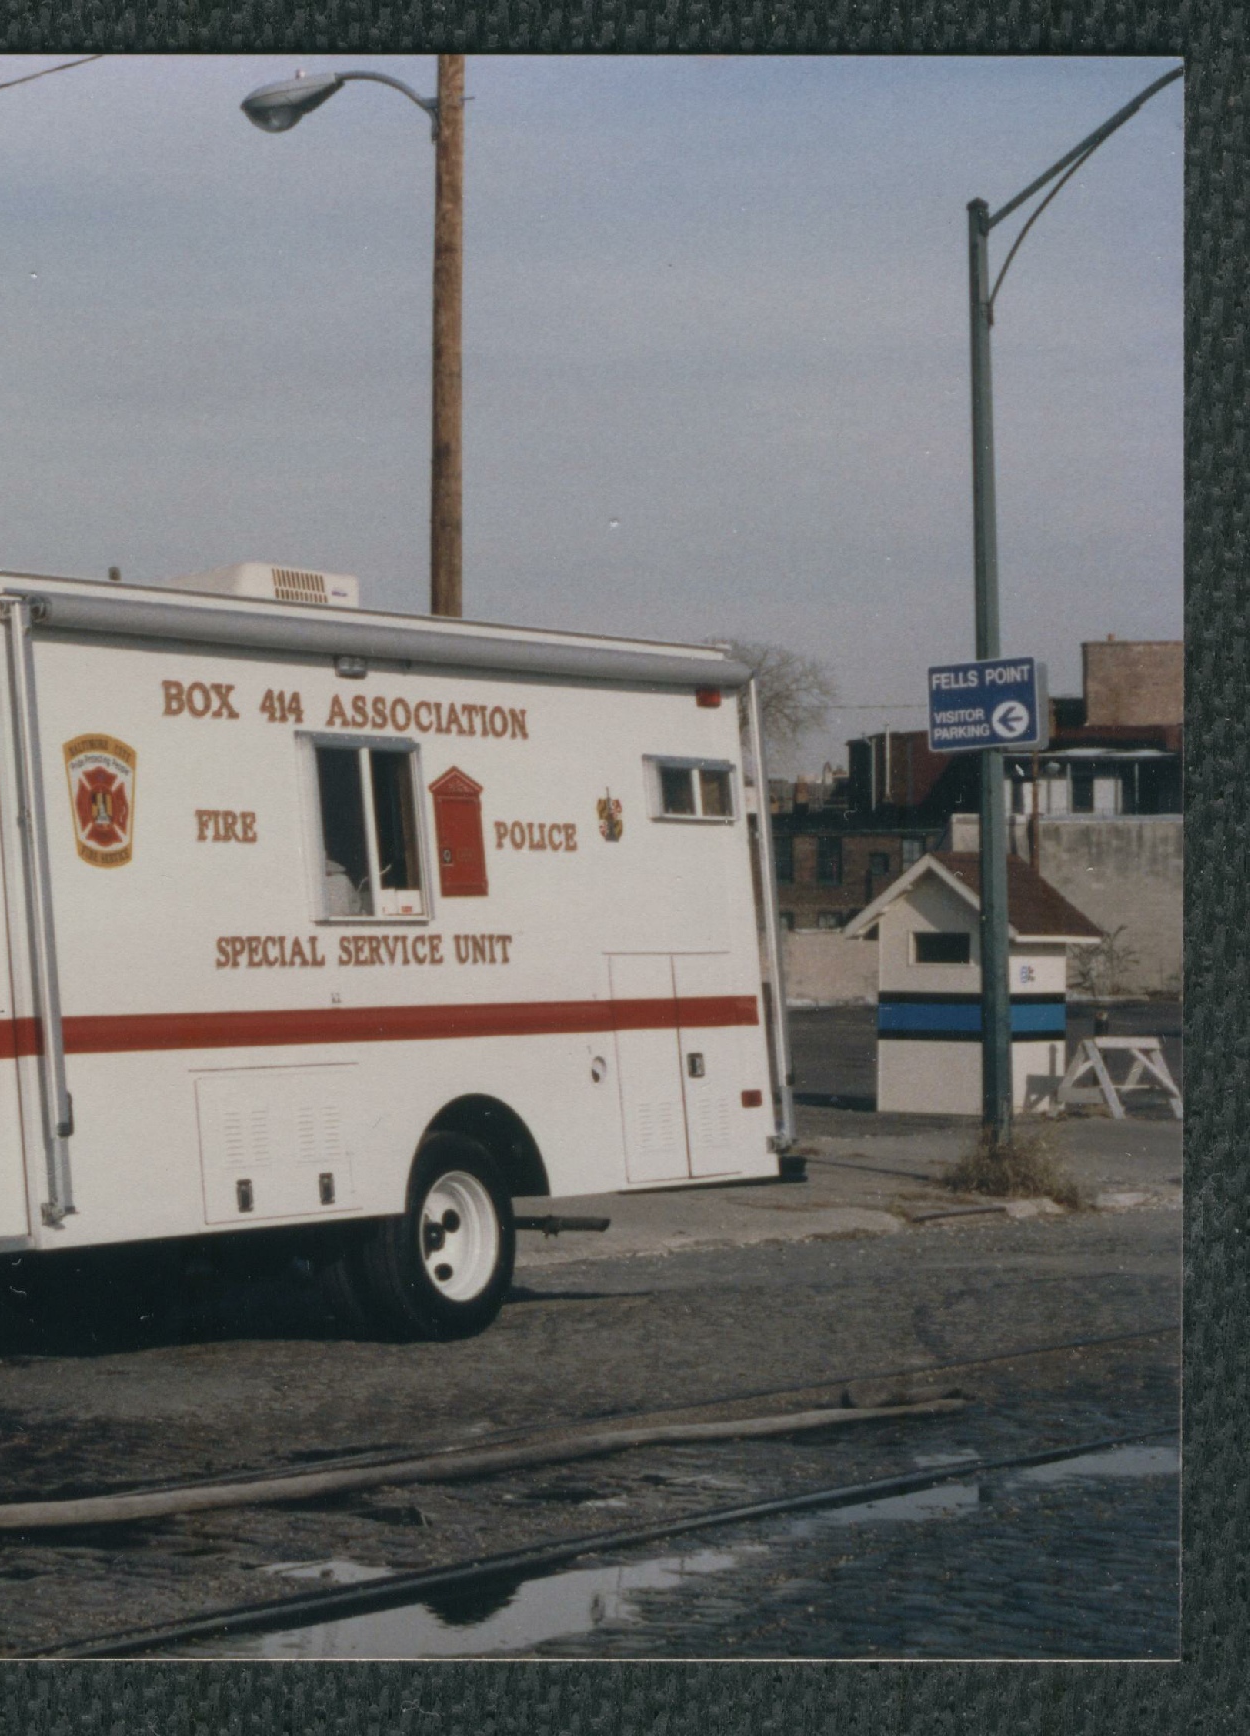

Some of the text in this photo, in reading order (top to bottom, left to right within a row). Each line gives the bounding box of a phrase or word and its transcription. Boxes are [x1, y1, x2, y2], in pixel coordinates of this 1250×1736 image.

[932, 665, 1030, 690] FELLS POINT
[161, 680, 529, 740] BOX 414 ASSOCIATION
[934, 709, 985, 724] VISITOR
[934, 723, 990, 740] PARKING
[195, 809, 258, 844] FIRE
[494, 820, 578, 852] POLICE
[215, 934, 512, 969] SPECIAL SERVICE UNIT
